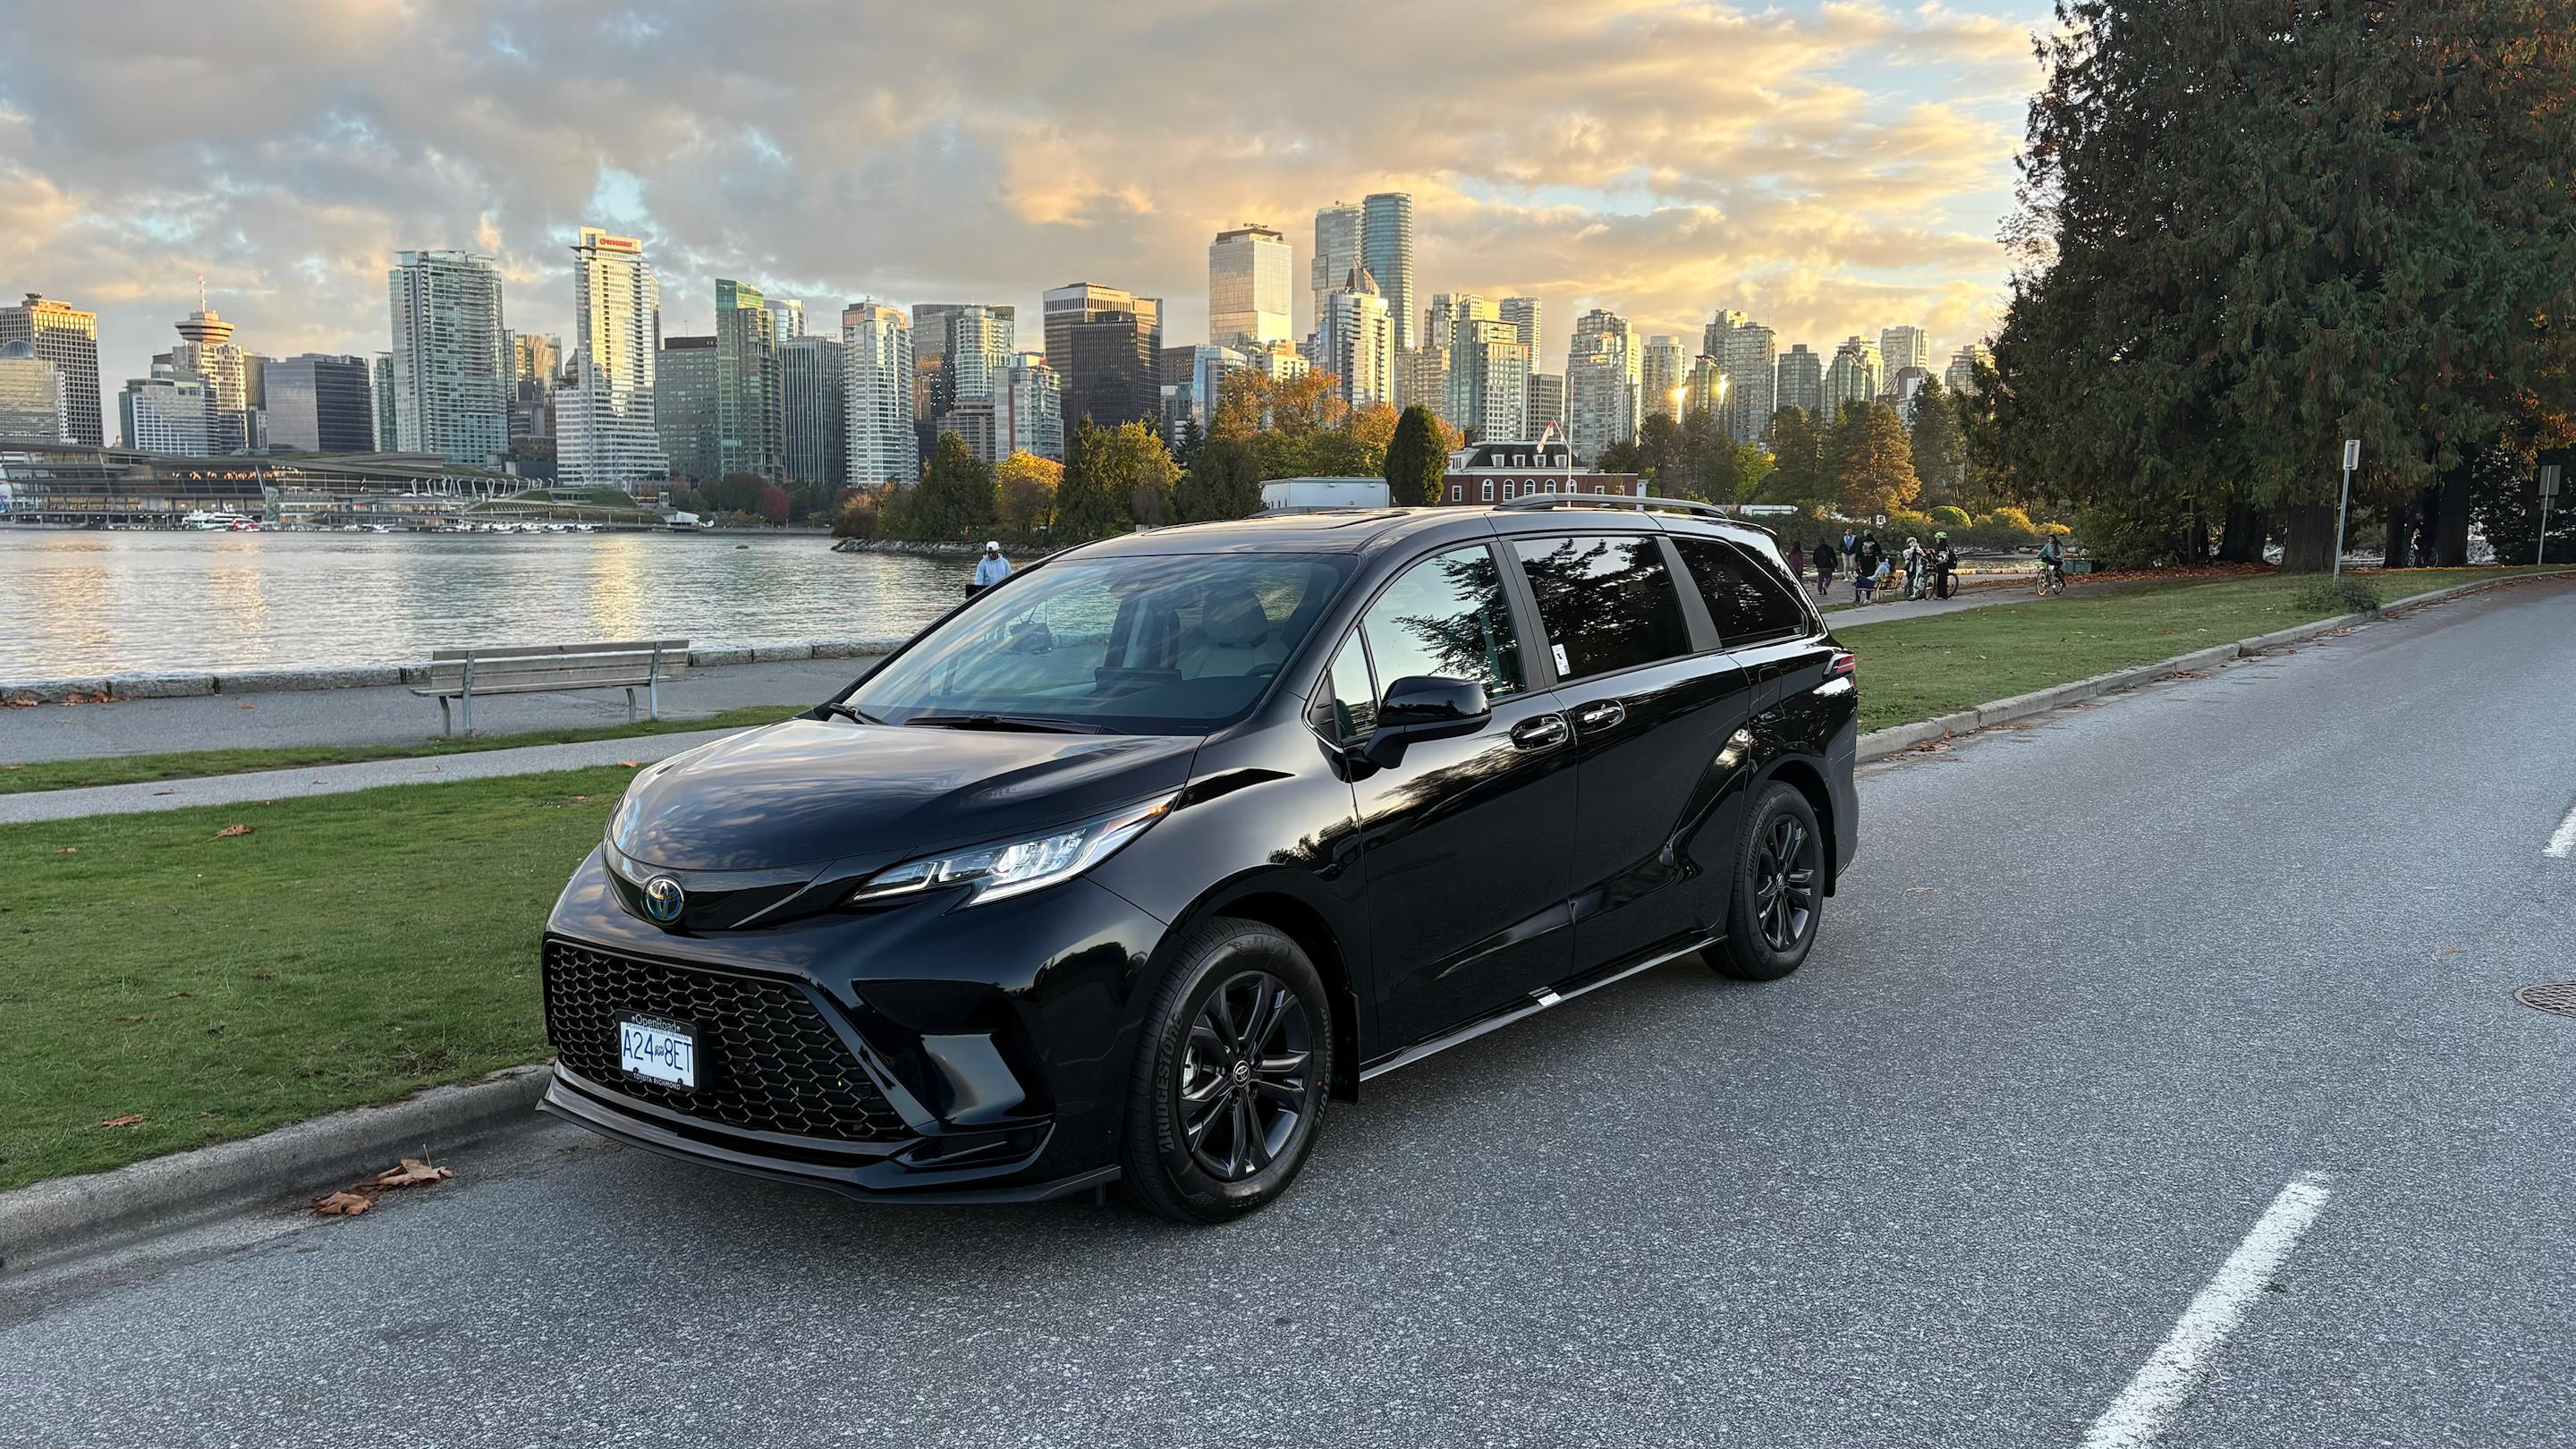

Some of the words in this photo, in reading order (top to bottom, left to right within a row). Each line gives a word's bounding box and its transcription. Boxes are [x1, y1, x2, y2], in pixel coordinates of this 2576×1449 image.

[635, 1013, 677, 1032] OpenRoad
[623, 1030, 654, 1063] A24
[664, 1038, 692, 1073] 8ET
[633, 1072, 653, 1084] TOYOTA
[653, 1078, 681, 1090] RICHMOND
[1156, 1013, 1183, 1154] BRIDGESTONE
